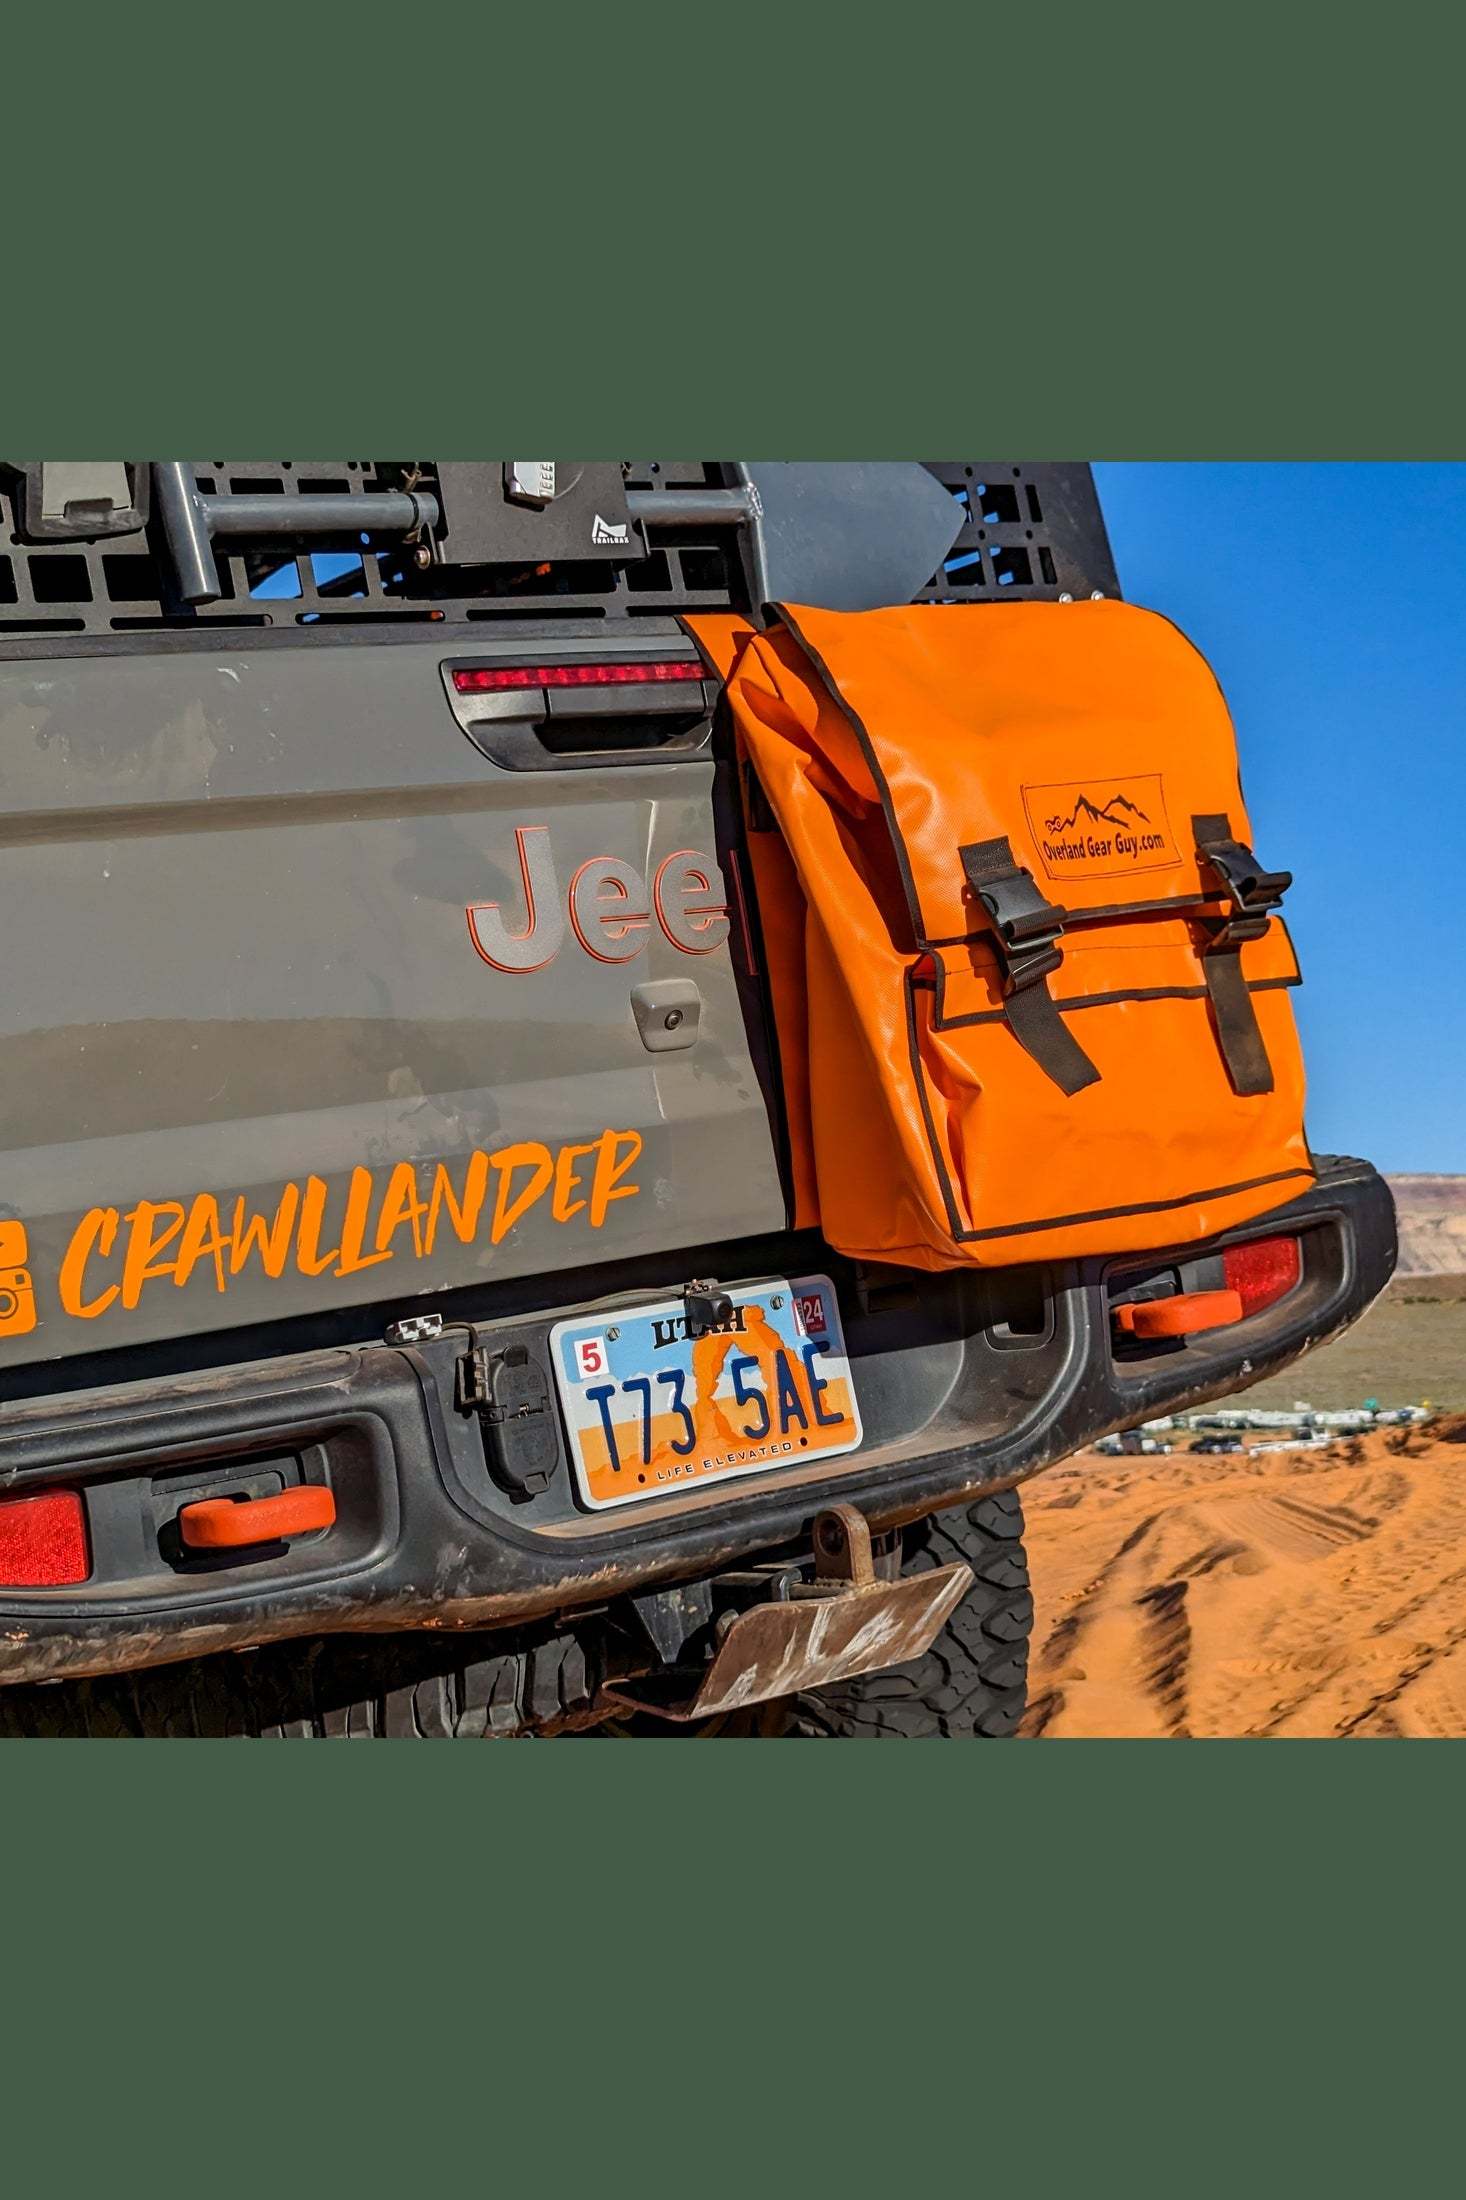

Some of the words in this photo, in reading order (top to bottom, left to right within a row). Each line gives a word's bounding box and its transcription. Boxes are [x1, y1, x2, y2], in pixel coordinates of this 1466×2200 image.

[1043, 837, 1086, 861] Overland
[1087, 836, 1112, 857] Gear
[1115, 832, 1165, 859] Guy.com
[466, 824, 758, 976] Jee
[57, 1129, 643, 1319] CRAWLLANDER
[803, 1299, 824, 1323] 24
[582, 1342, 602, 1373] 5
[586, 1369, 696, 1472] T73
[731, 1341, 845, 1439] 5AE
[657, 1464, 694, 1480] LIFE
[703, 1442, 792, 1468] ELEVATED
